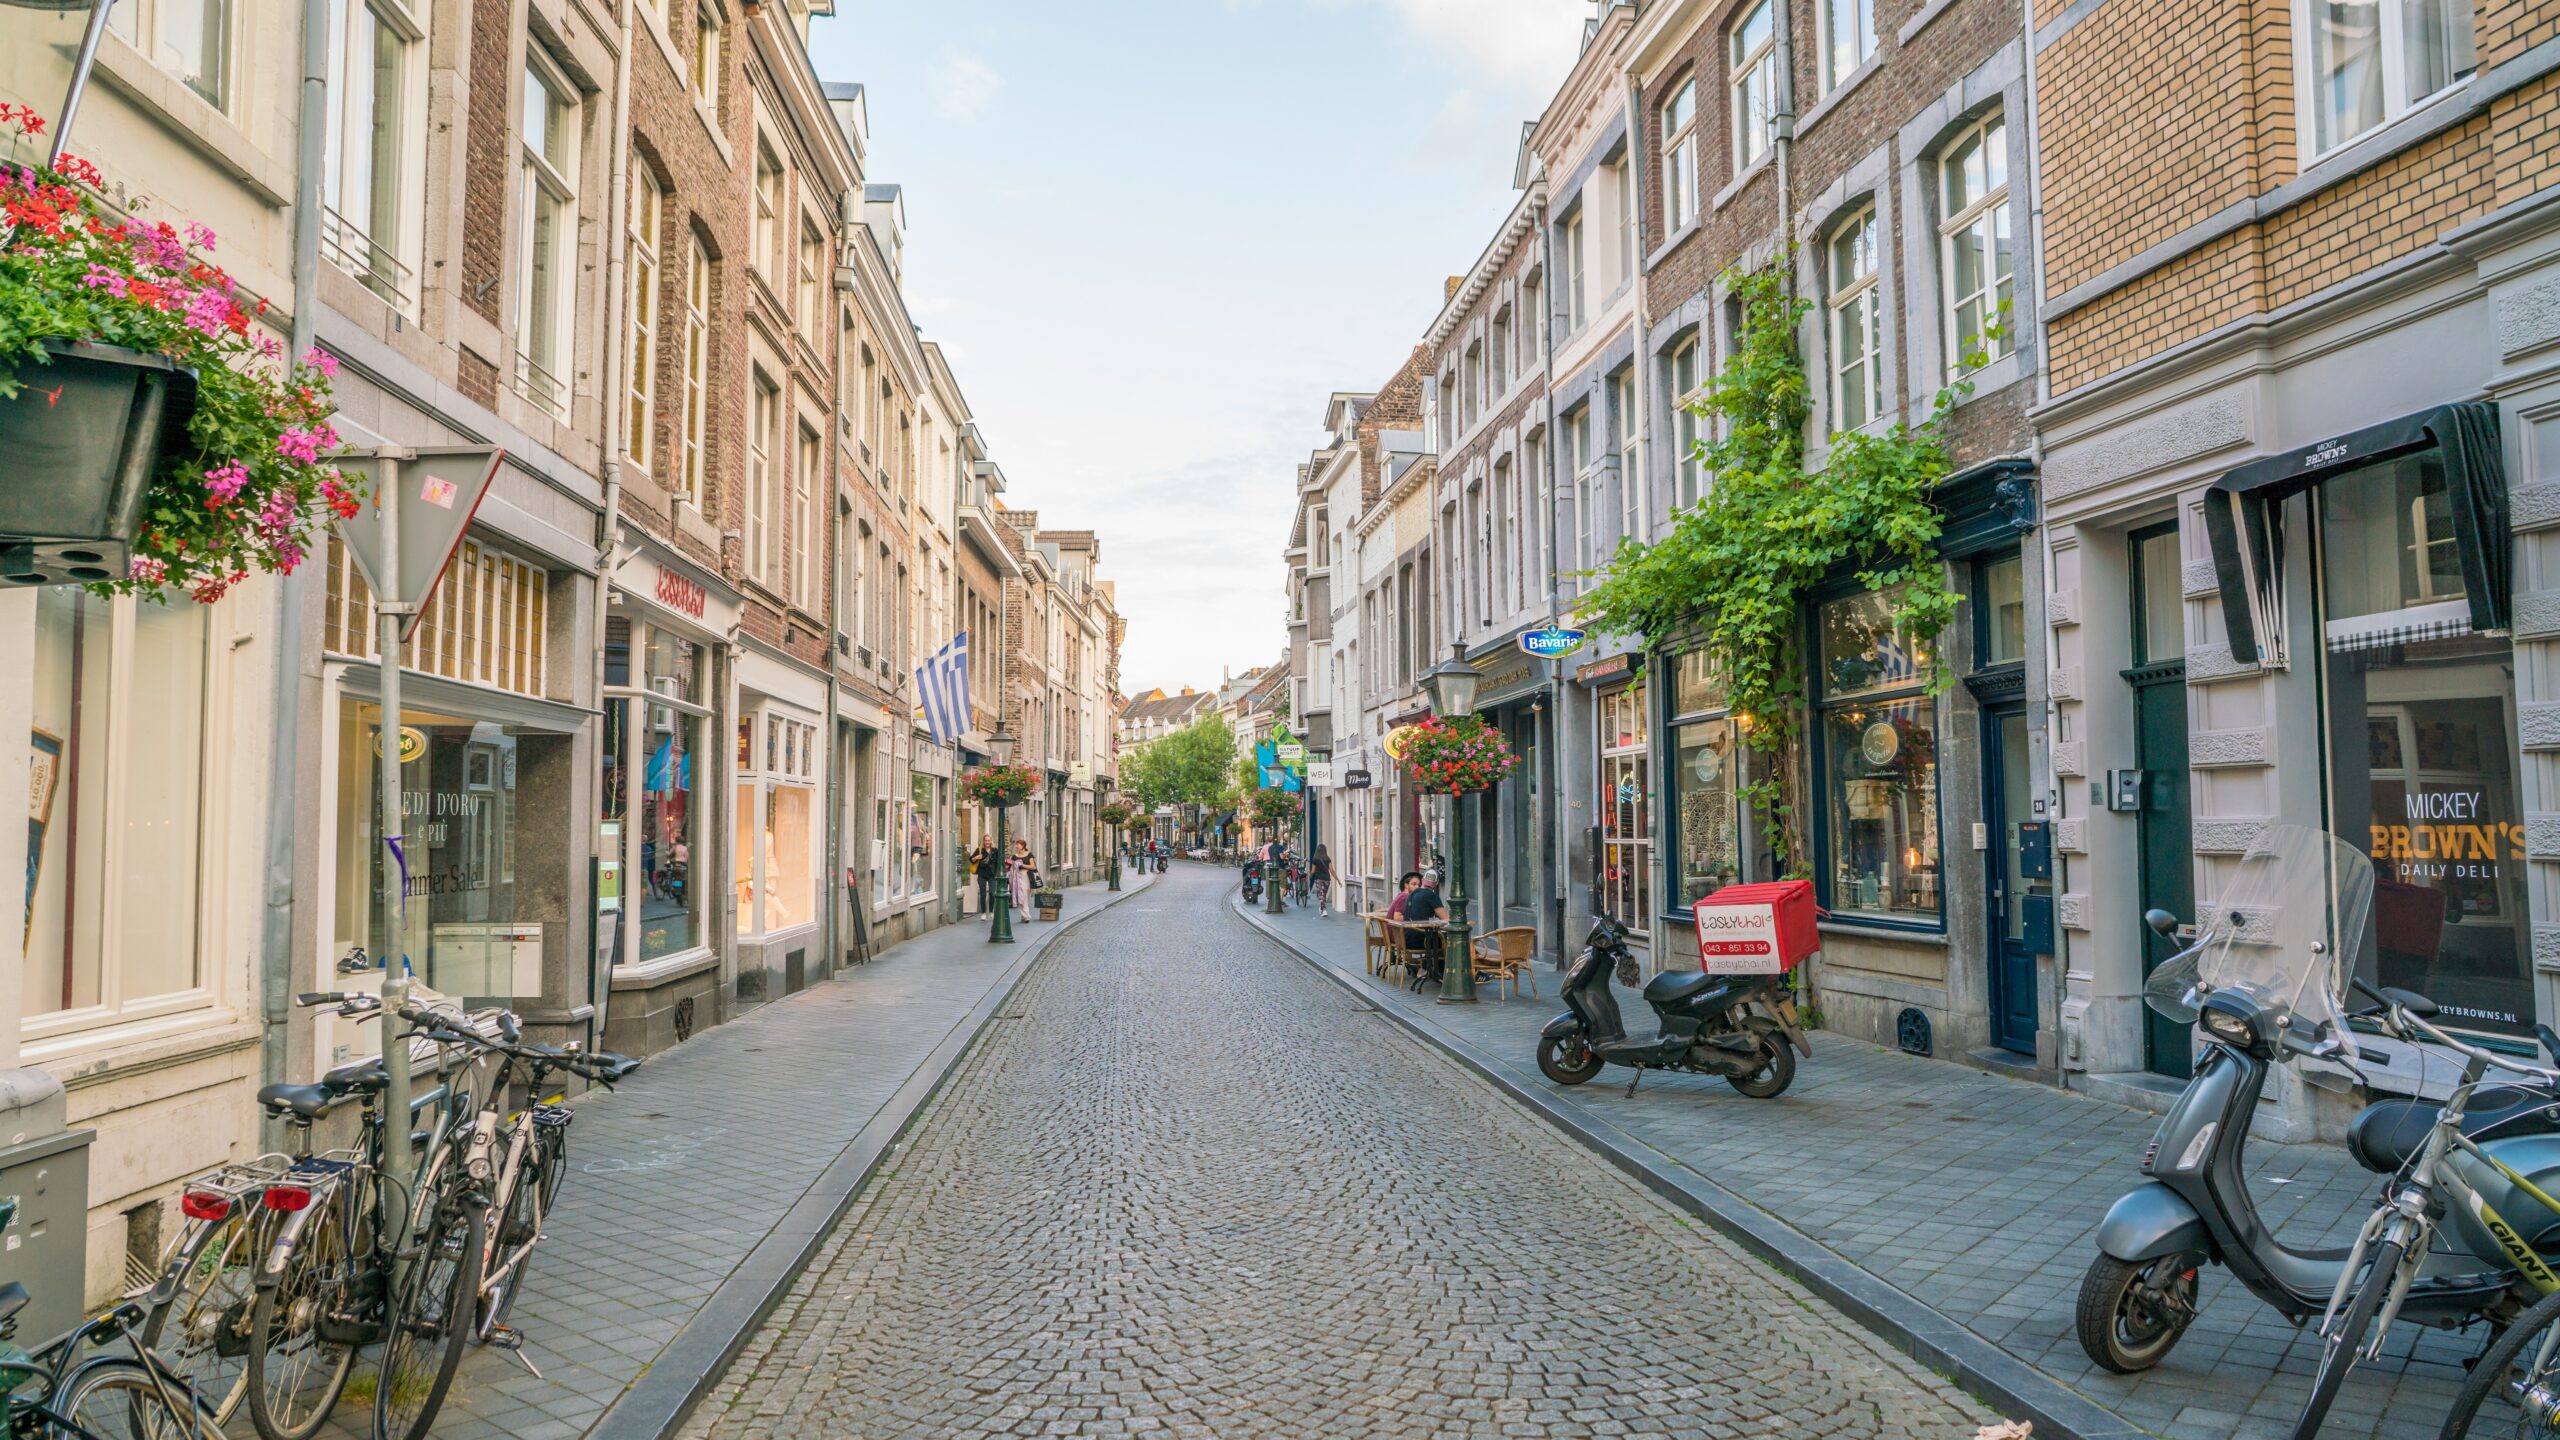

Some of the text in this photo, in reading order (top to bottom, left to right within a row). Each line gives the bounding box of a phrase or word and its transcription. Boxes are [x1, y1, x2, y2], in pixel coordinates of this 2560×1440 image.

[2305, 444, 2348, 467] BROWN'S
[1529, 635, 1578, 650] Bavaria
[402, 791, 479, 816] EDI D'ORO
[1570, 800, 1582, 809] 40
[2406, 792, 2480, 819] MICKEY
[418, 819, 448, 842] e PIÙ
[2370, 821, 2526, 860] BROWN'S
[404, 863, 478, 897] mmer Sale
[2401, 863, 2499, 878] DAILY DELI
[1705, 944, 1720, 953] 043
[1729, 944, 1741, 952] 851
[1744, 943, 1755, 952] 33
[1757, 943, 1768, 952] 94
[1707, 959, 1771, 971] tastythai.nl
[2438, 1004, 2517, 1023] KEYBROWNS.NL
[2489, 1221, 2555, 1283] GIANT
